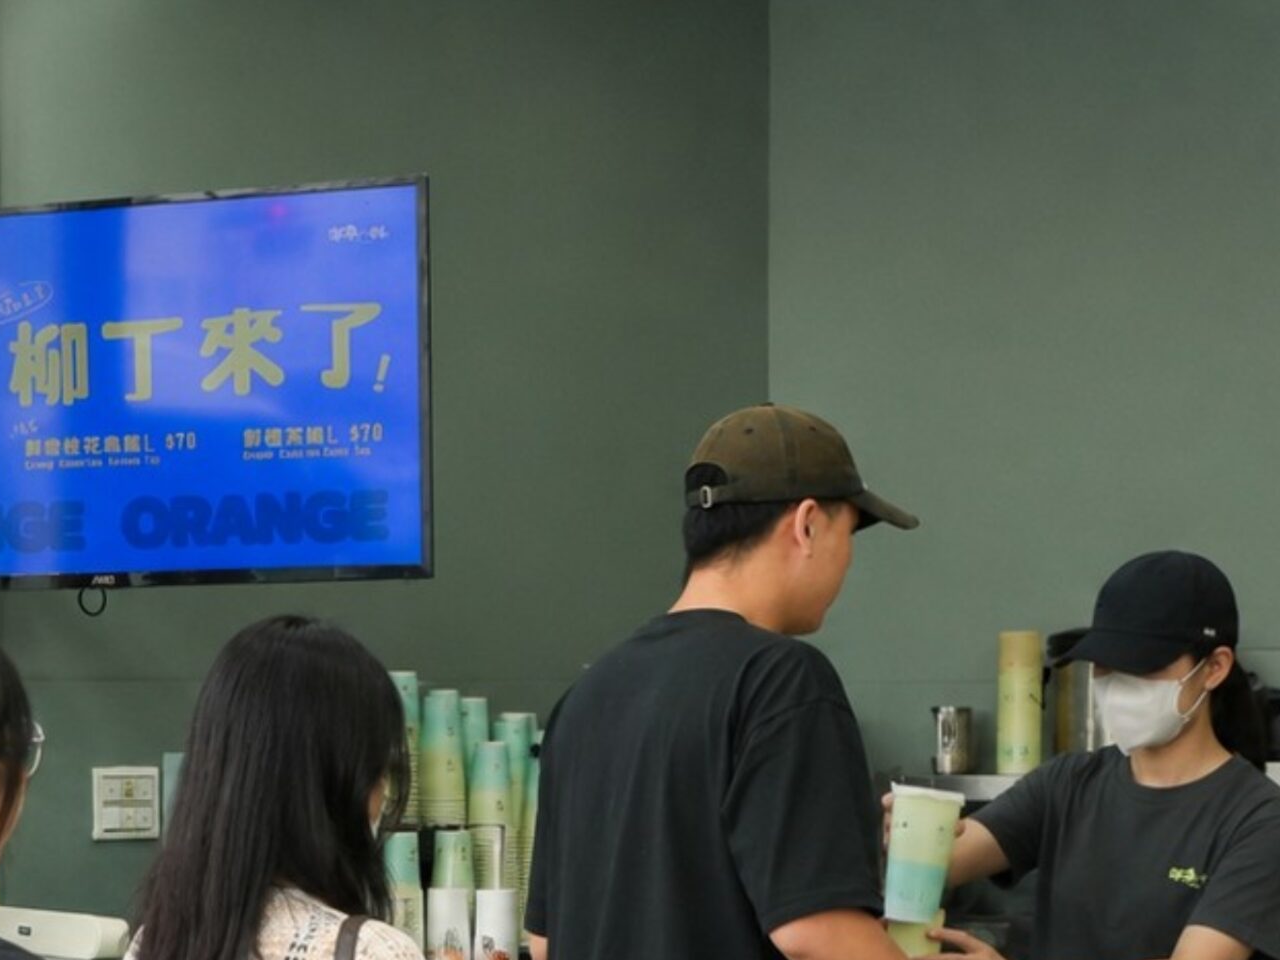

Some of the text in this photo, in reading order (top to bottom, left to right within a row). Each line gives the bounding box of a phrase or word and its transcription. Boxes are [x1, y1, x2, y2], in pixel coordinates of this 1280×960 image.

[9, 301, 392, 407] 柳丁來了!
[124, 490, 390, 550] ORANGE
